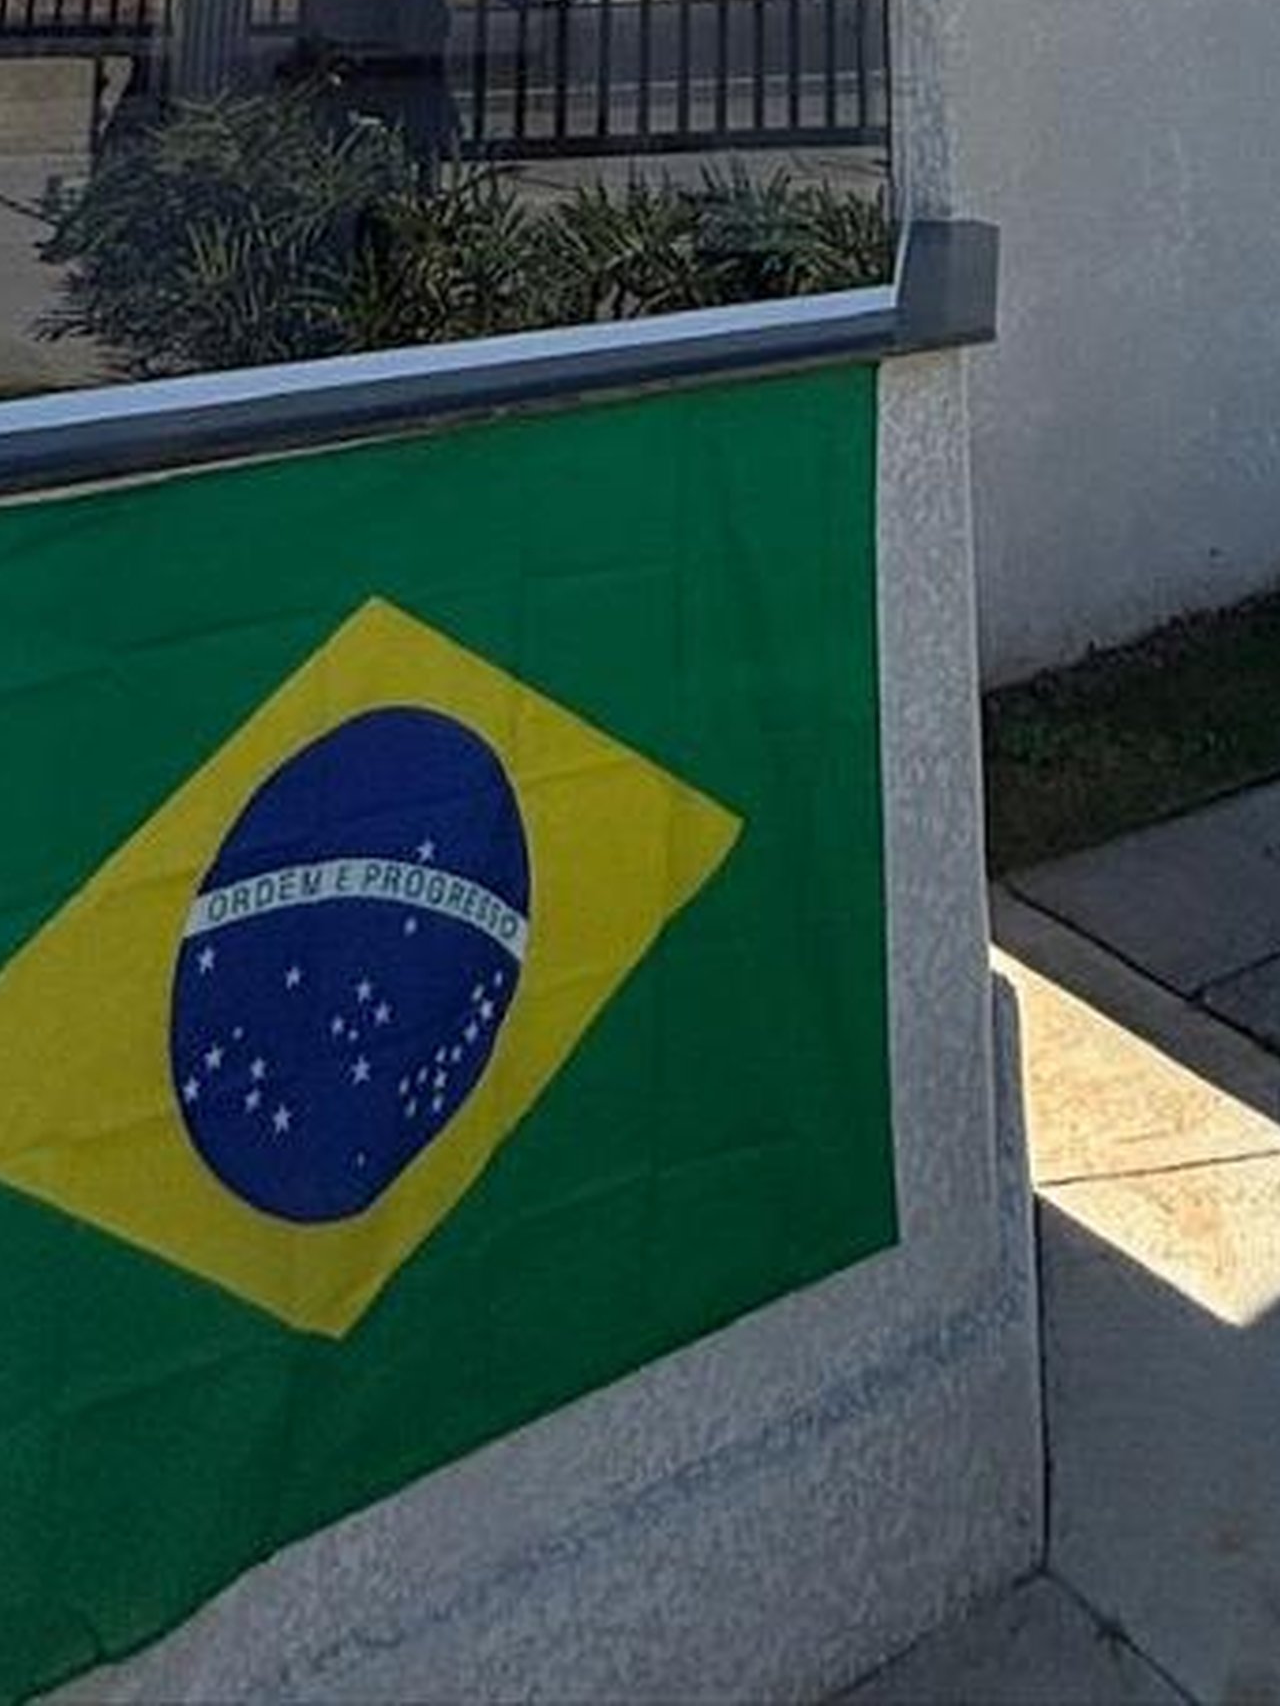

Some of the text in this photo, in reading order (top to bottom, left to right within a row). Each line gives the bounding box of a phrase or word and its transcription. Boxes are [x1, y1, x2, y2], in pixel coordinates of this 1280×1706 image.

[207, 863, 520, 940] ORDEM E PROGRESSO
